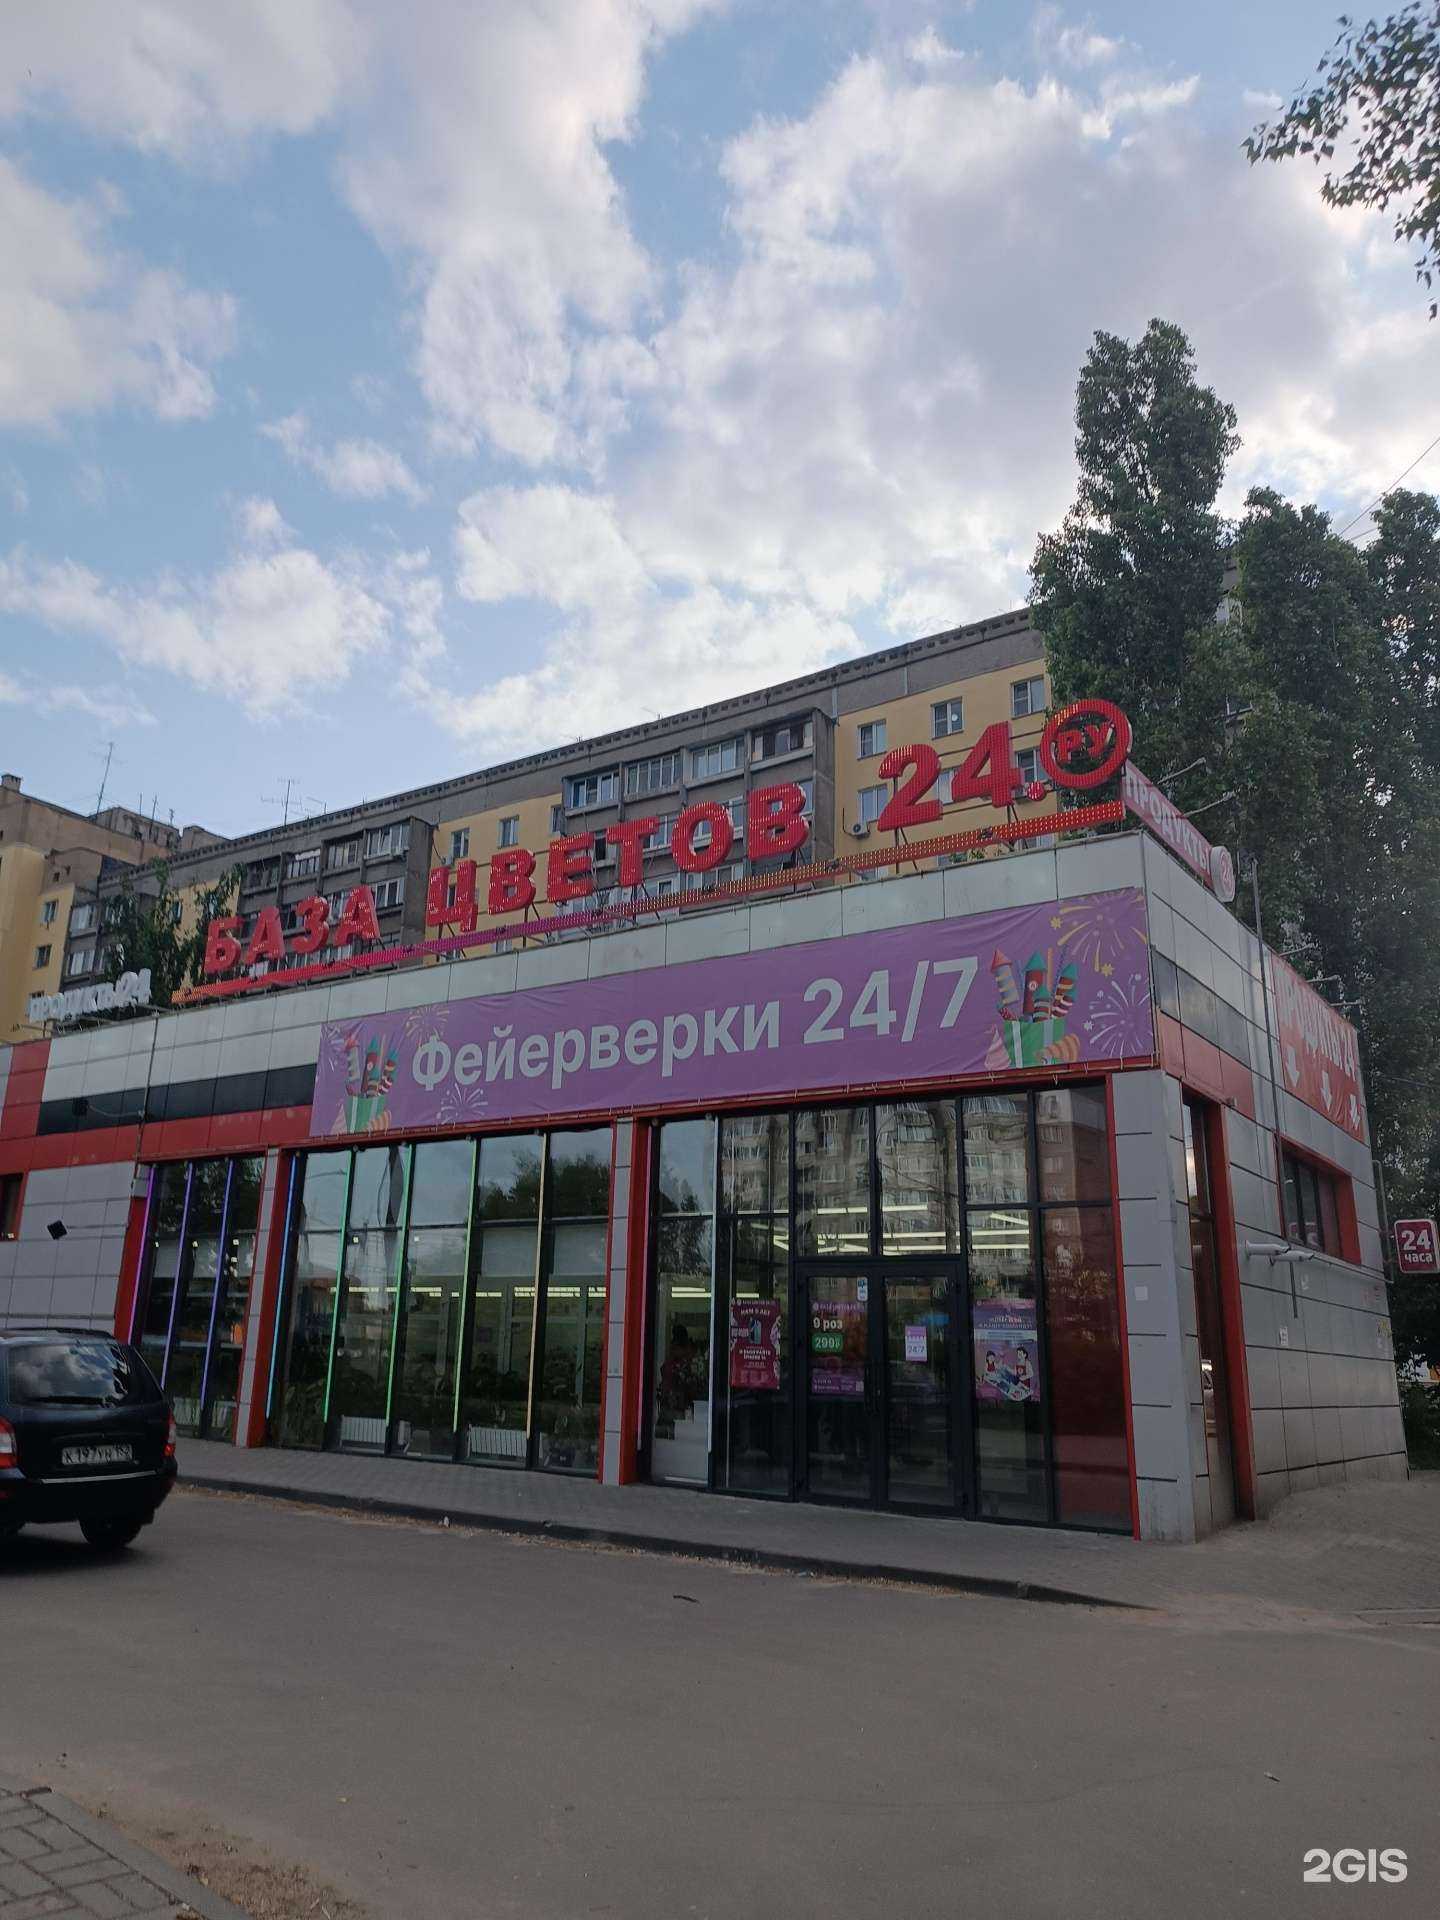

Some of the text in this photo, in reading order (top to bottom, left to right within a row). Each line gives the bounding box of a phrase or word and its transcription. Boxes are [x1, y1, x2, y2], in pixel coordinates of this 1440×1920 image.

[1125, 765, 1211, 875] ПРОДУКТЫ
[205, 885, 380, 974] БАЗА
[427, 783, 809, 932] ЦВЕТОВ
[411, 956, 979, 1091] Фейерверки 24/7
[1401, 1229, 1431, 1251] 24
[1404, 1253, 1433, 1264] часа
